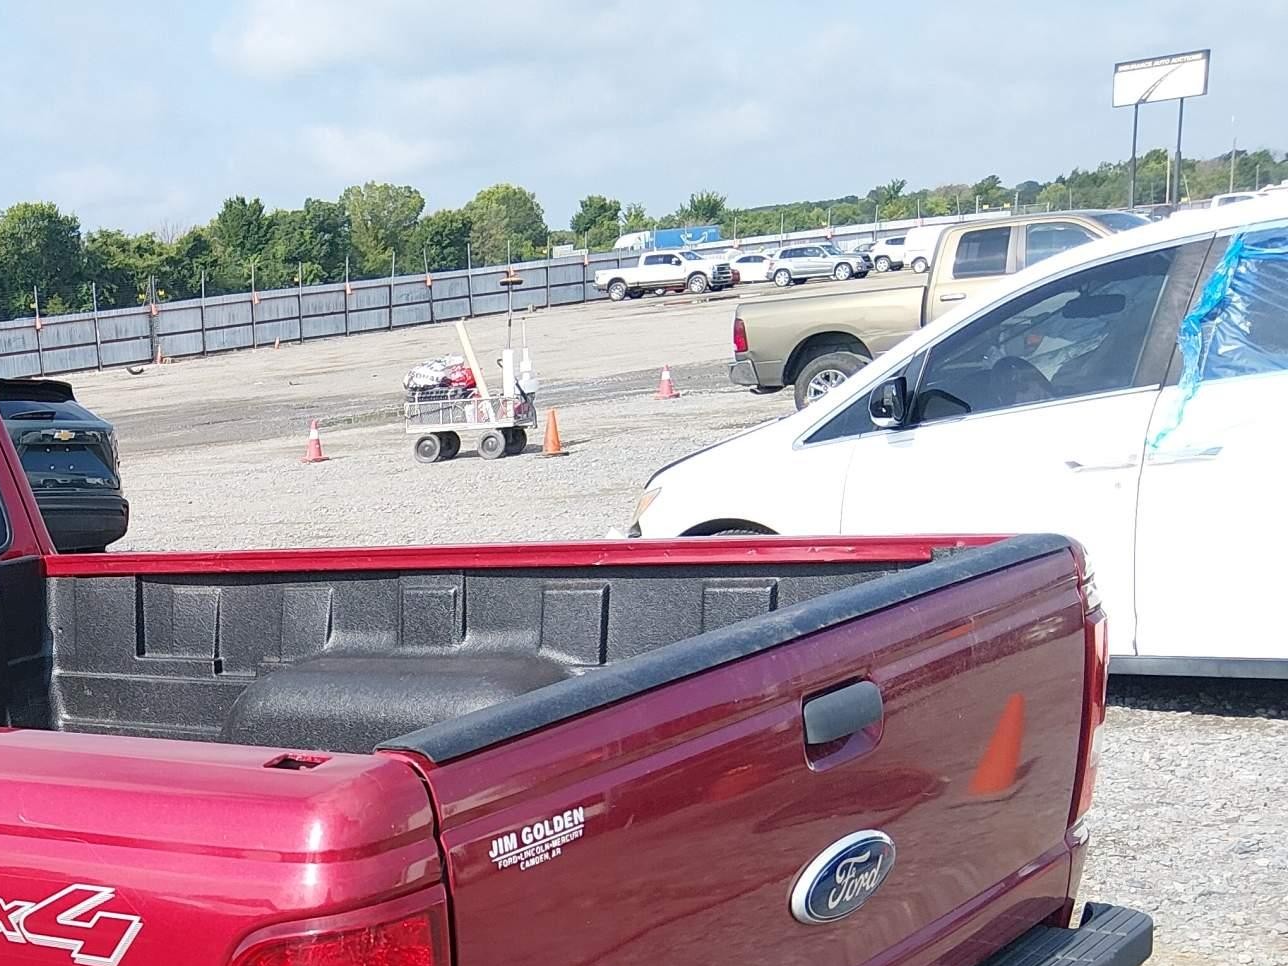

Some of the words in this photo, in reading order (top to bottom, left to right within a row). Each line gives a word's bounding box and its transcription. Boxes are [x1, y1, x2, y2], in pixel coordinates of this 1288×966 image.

[489, 832, 518, 859] JIM
[521, 806, 585, 845] GOLDEN
[551, 847, 562, 859] AR
[827, 849, 883, 910] Ford
